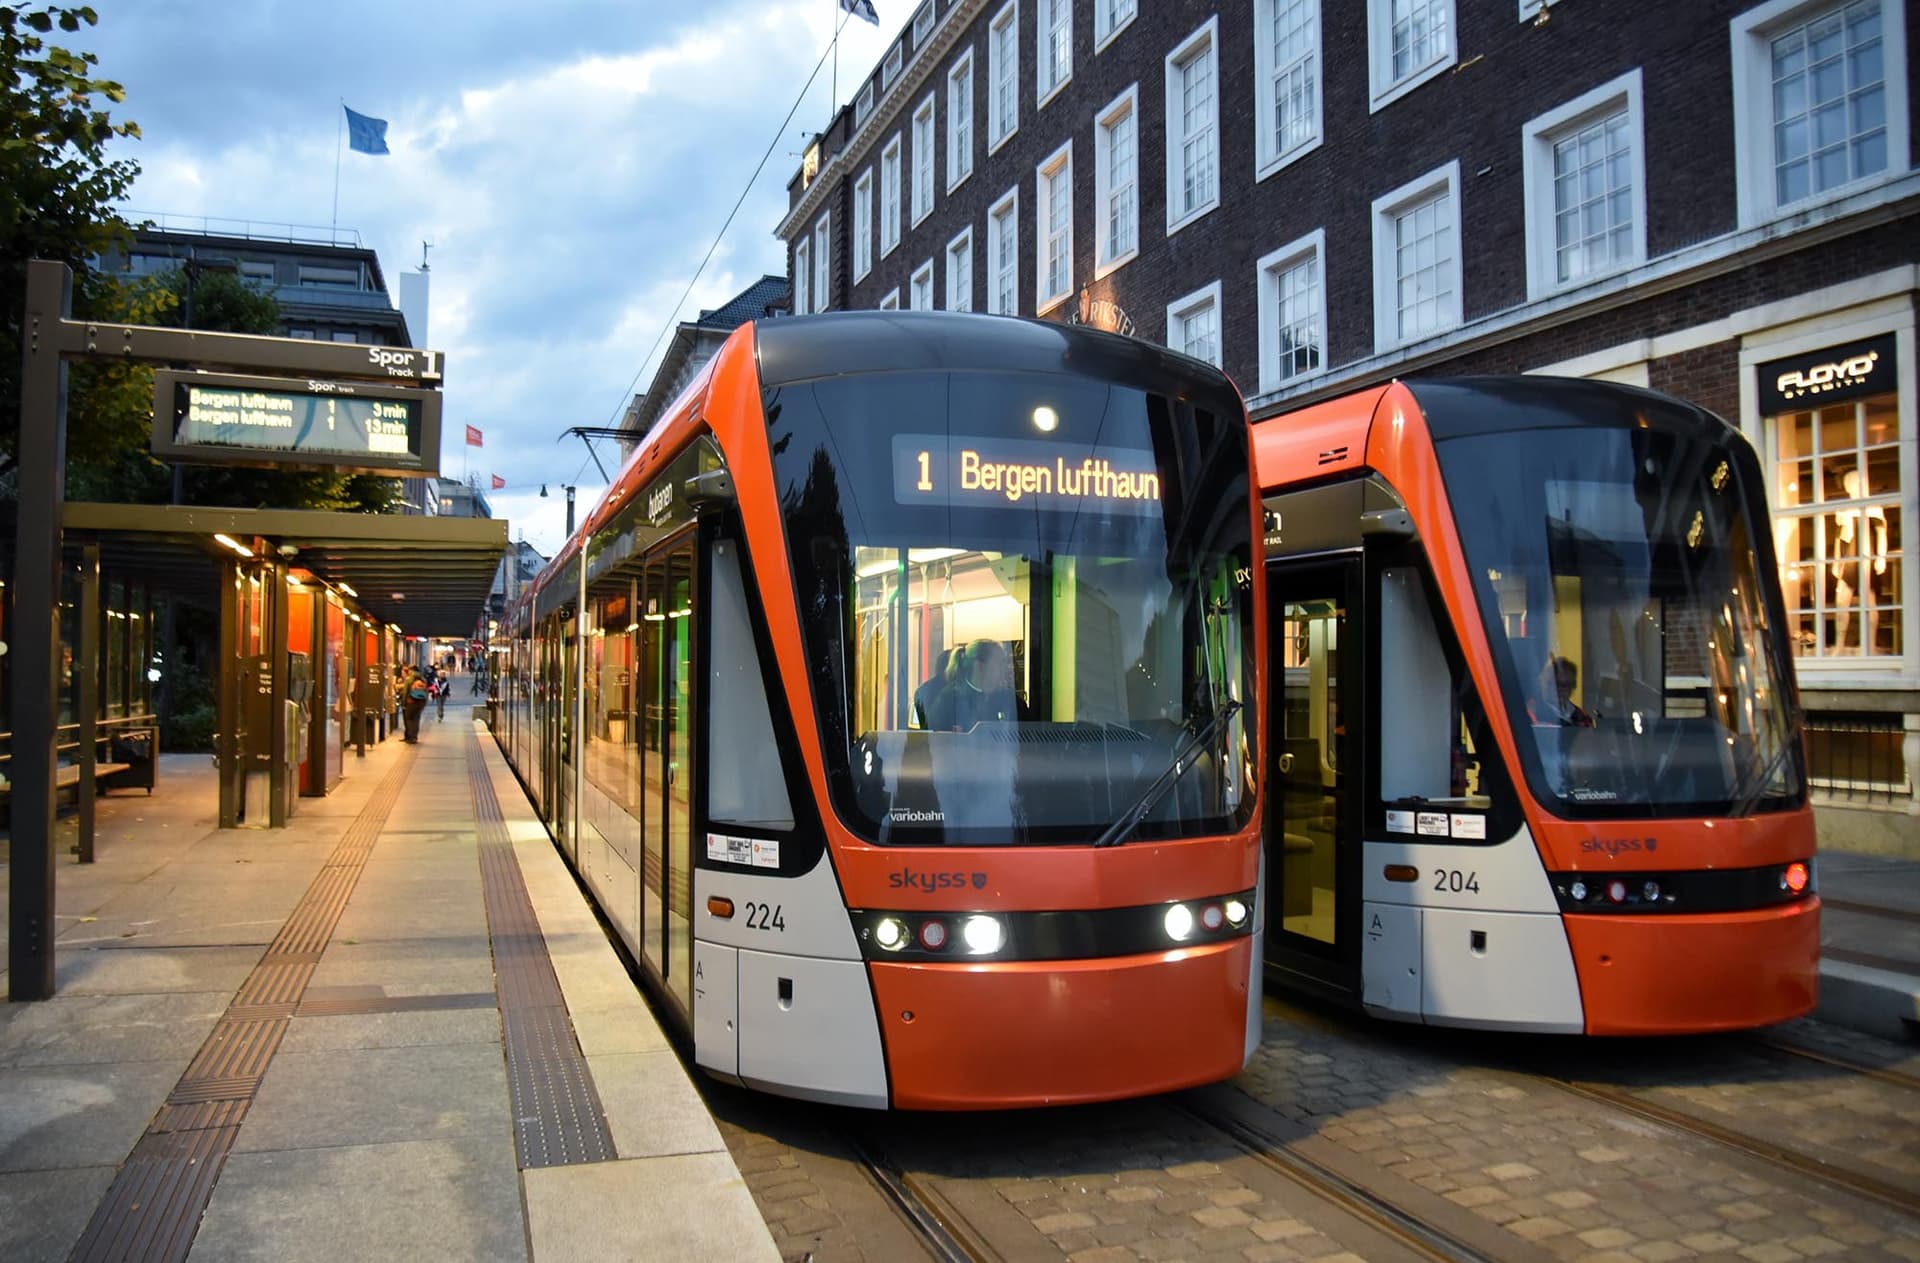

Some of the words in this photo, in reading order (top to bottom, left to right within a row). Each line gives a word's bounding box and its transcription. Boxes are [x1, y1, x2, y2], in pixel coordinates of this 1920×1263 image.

[368, 347, 414, 367] Spor
[421, 351, 441, 379] 1
[387, 366, 414, 377] Track
[1777, 354, 1873, 392] FLOYD
[308, 380, 335, 393] Spor
[189, 388, 239, 409] Bergen
[241, 392, 293, 411] lufthavn
[327, 399, 335, 414] 1
[383, 404, 407, 419] min
[189, 405, 239, 425] Bergen
[241, 409, 292, 428] lufthavn
[327, 415, 335, 431] 1
[382, 420, 406, 435] min
[917, 451, 933, 491] 1
[961, 451, 1051, 501] Bergen
[1057, 457, 1159, 500] lufthavn
[890, 810, 945, 822] variobahn
[1582, 836, 1642, 857] skyss
[888, 867, 967, 894] skyss
[1434, 869, 1480, 894] 204
[745, 901, 785, 932] 224
